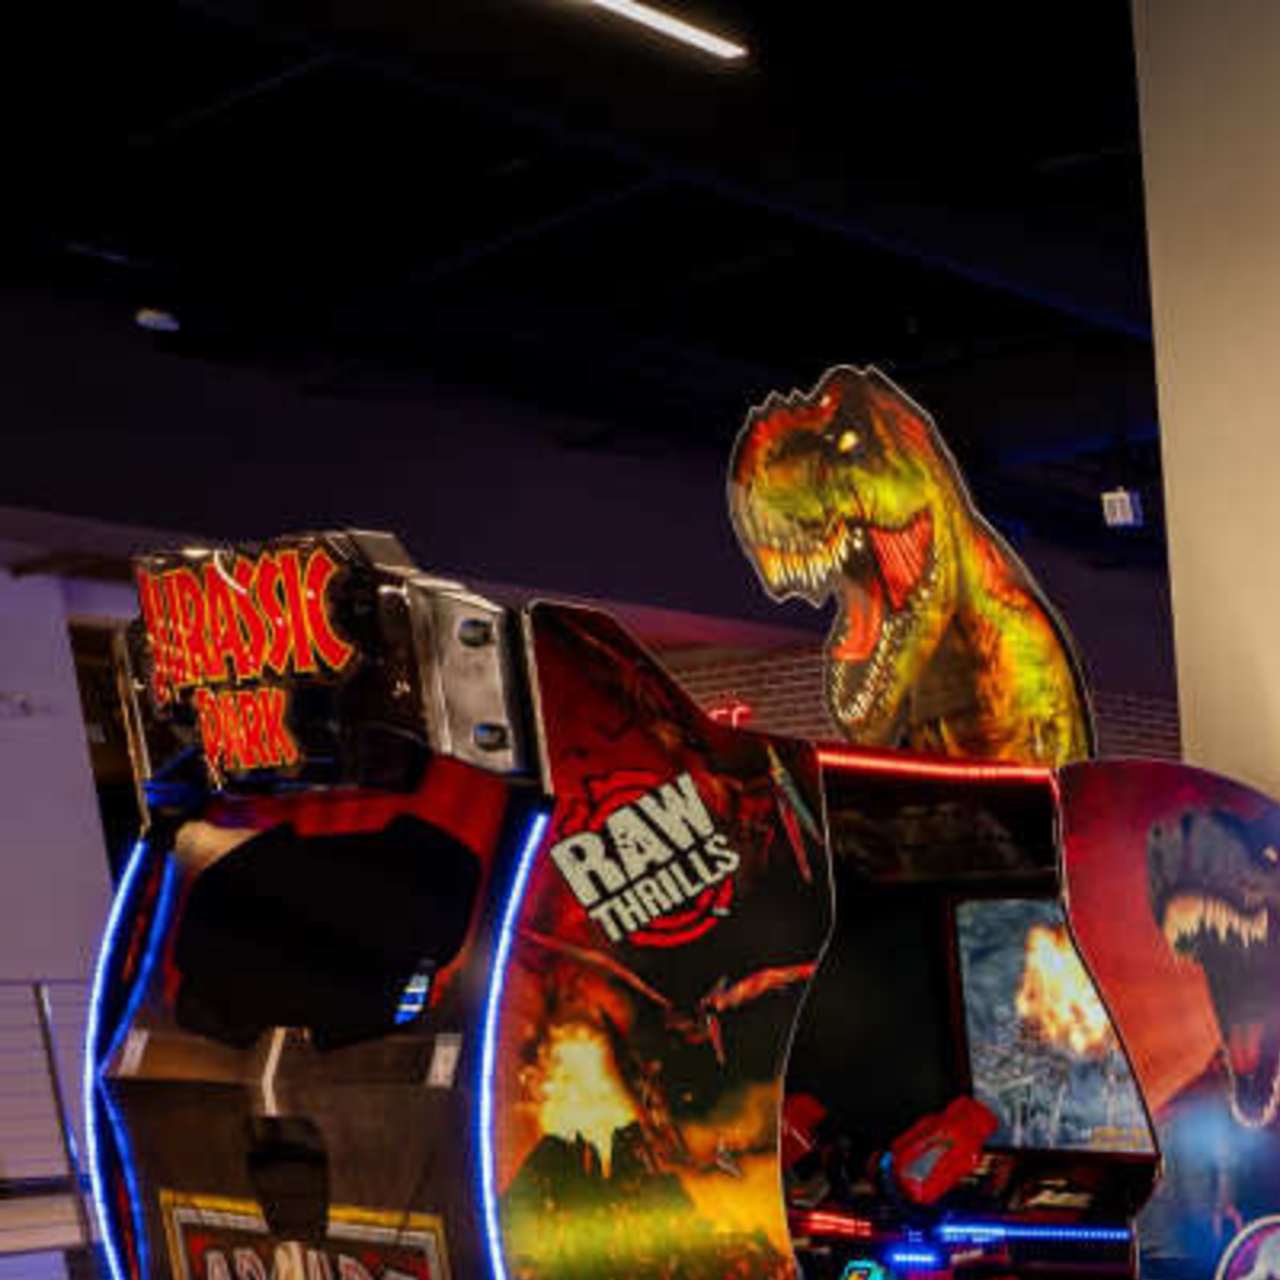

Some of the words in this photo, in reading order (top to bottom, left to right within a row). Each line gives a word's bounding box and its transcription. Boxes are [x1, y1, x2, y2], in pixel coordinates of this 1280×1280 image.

[136, 547, 353, 706] JURASSIC
[195, 686, 299, 778] PARK
[550, 772, 715, 908] RAW
[587, 833, 741, 942] THRILLS
